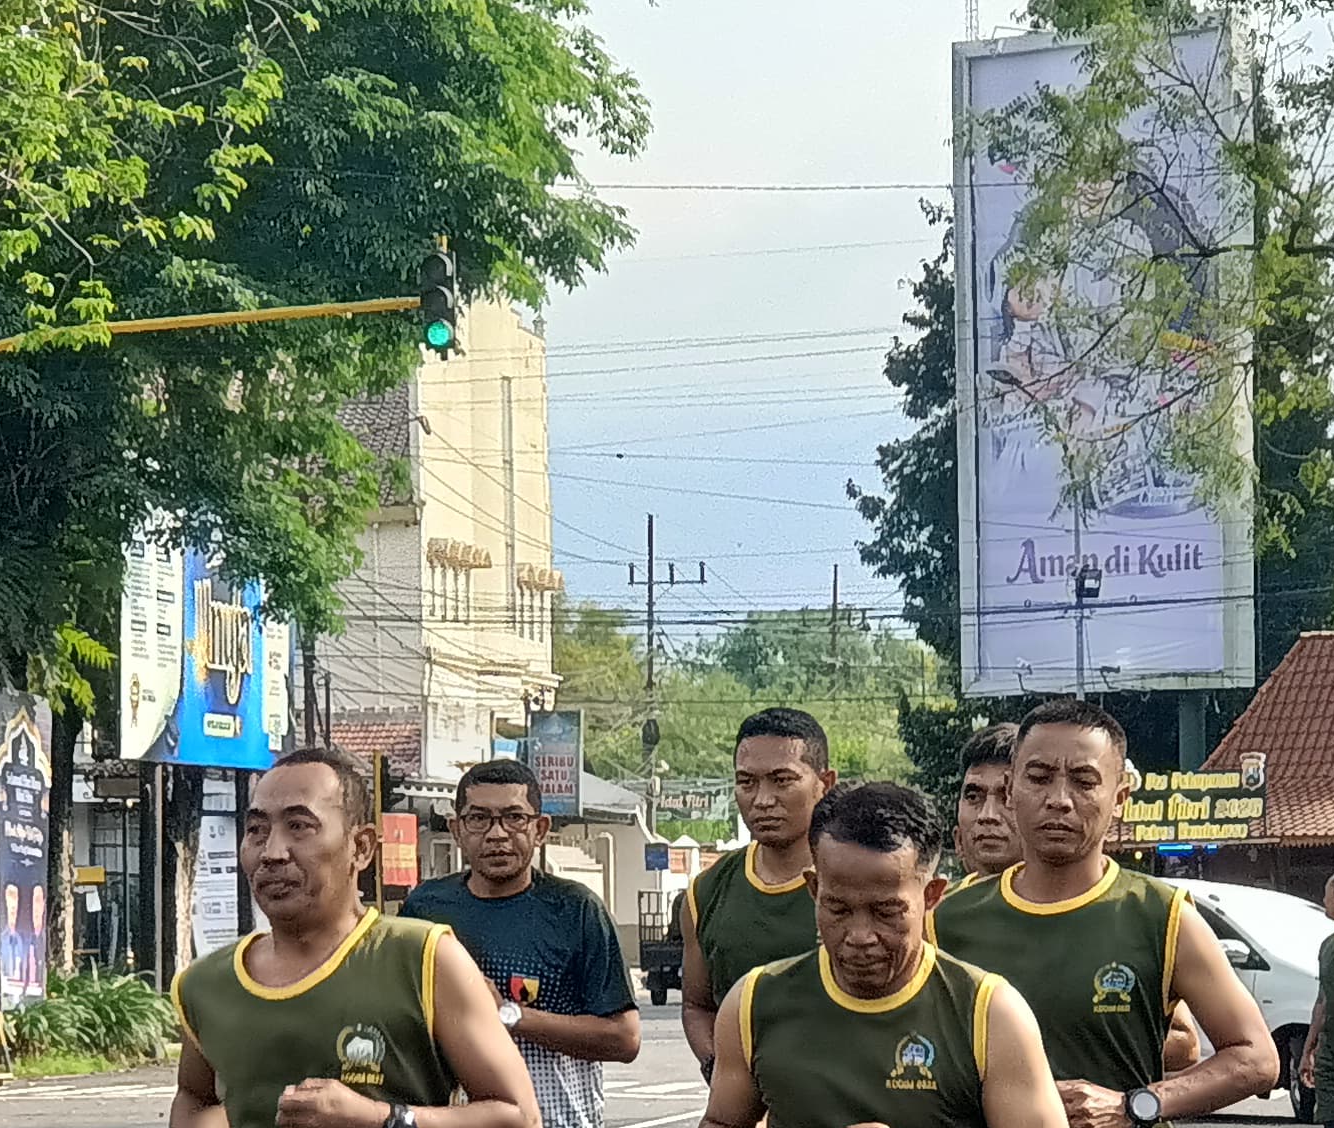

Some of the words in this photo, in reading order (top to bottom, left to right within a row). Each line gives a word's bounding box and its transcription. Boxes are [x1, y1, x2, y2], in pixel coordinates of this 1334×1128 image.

[1006, 538, 1099, 583] Aman
[1104, 545, 1130, 575] di
[1137, 543, 1203, 577] Kulit
[534, 756, 574, 768] SERIBU
[540, 769, 569, 781] SATU
